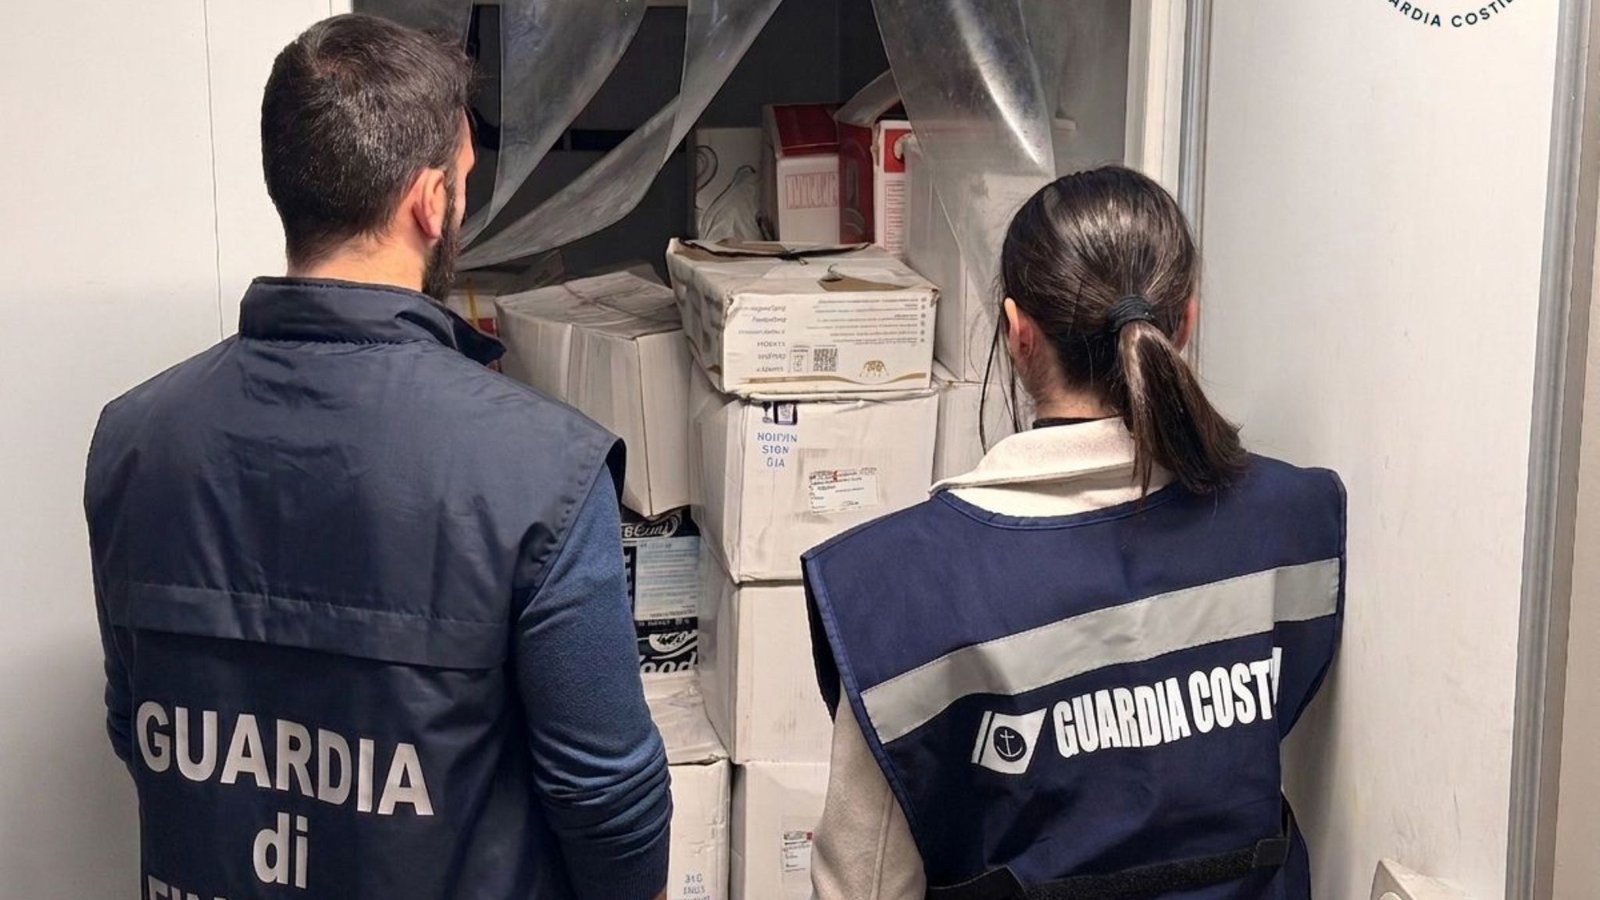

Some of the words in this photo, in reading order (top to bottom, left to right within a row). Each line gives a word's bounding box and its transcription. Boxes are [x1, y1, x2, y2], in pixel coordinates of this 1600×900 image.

[1053, 677, 1192, 758] GUARDIA
[136, 701, 435, 816] GUARDIA
[253, 812, 308, 889] di
